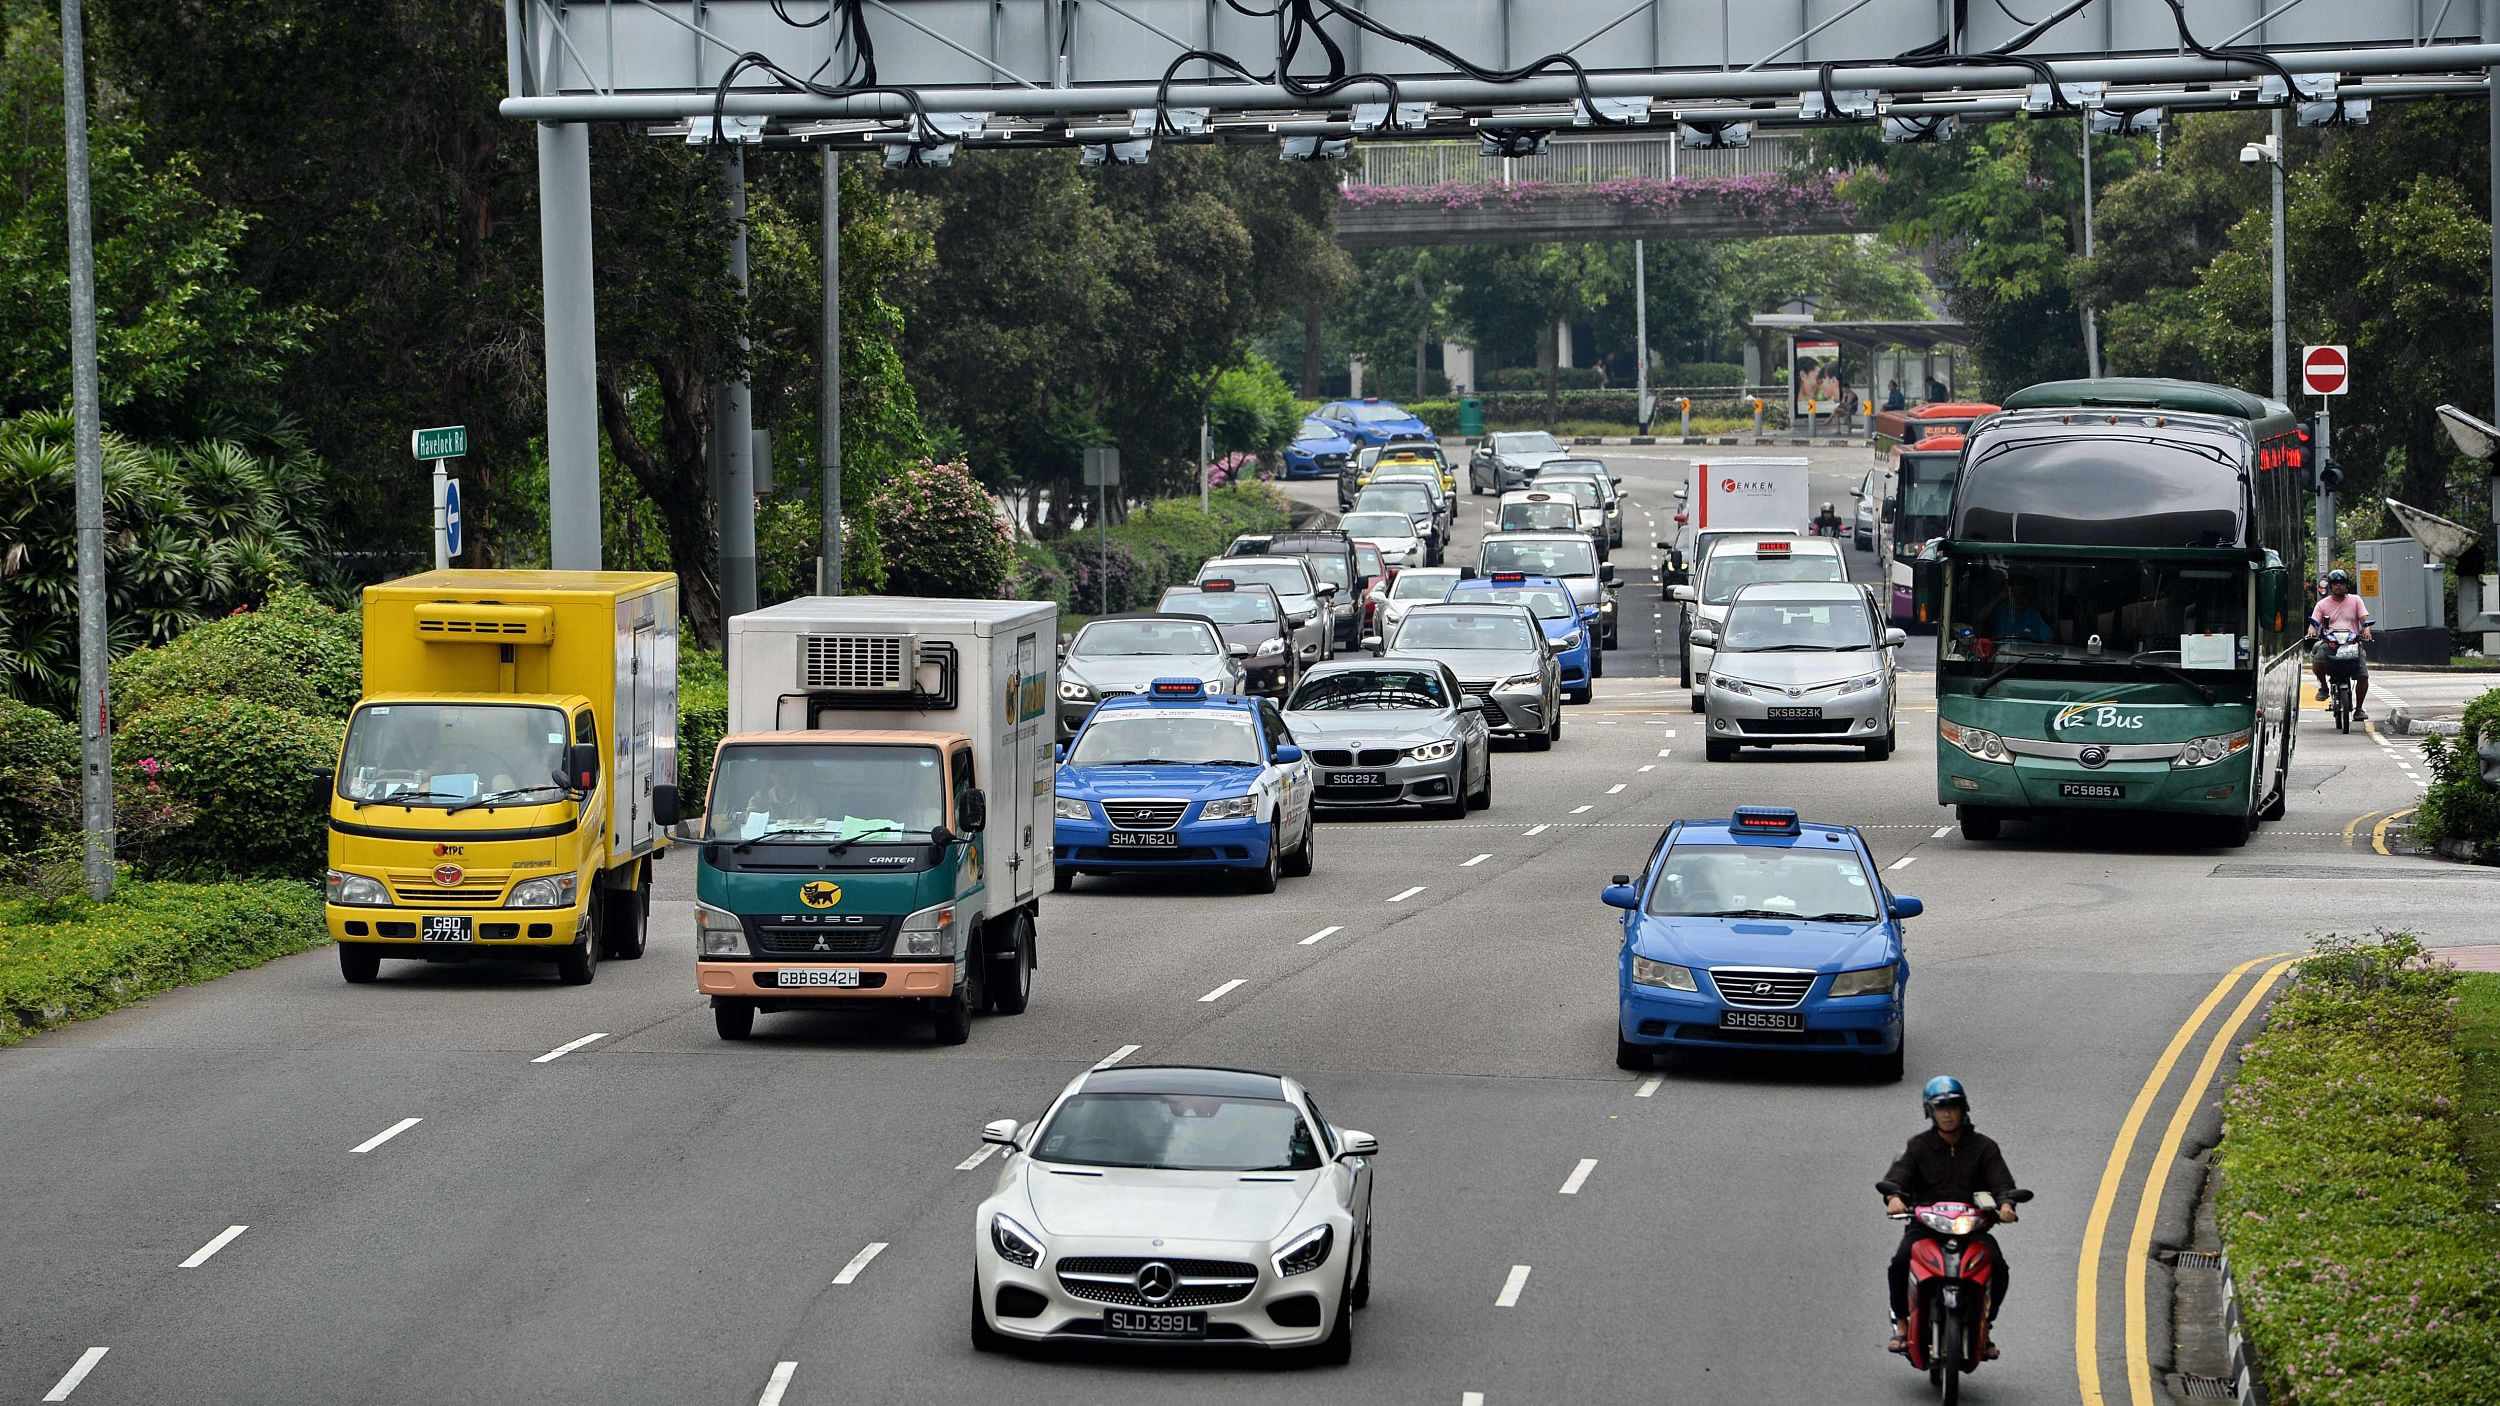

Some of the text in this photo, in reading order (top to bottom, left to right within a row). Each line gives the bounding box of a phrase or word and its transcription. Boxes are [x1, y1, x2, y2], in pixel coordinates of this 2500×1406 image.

[420, 431, 464, 456] Havelock Rd
[2096, 706, 2144, 730] Bus
[2063, 785, 2120, 797] PC5885A
[868, 856, 916, 864] CANTER
[433, 917, 461, 929] GBD
[781, 915, 864, 923] FUSO
[423, 928, 471, 941] 2773U
[780, 971, 858, 985] GBB6942H
